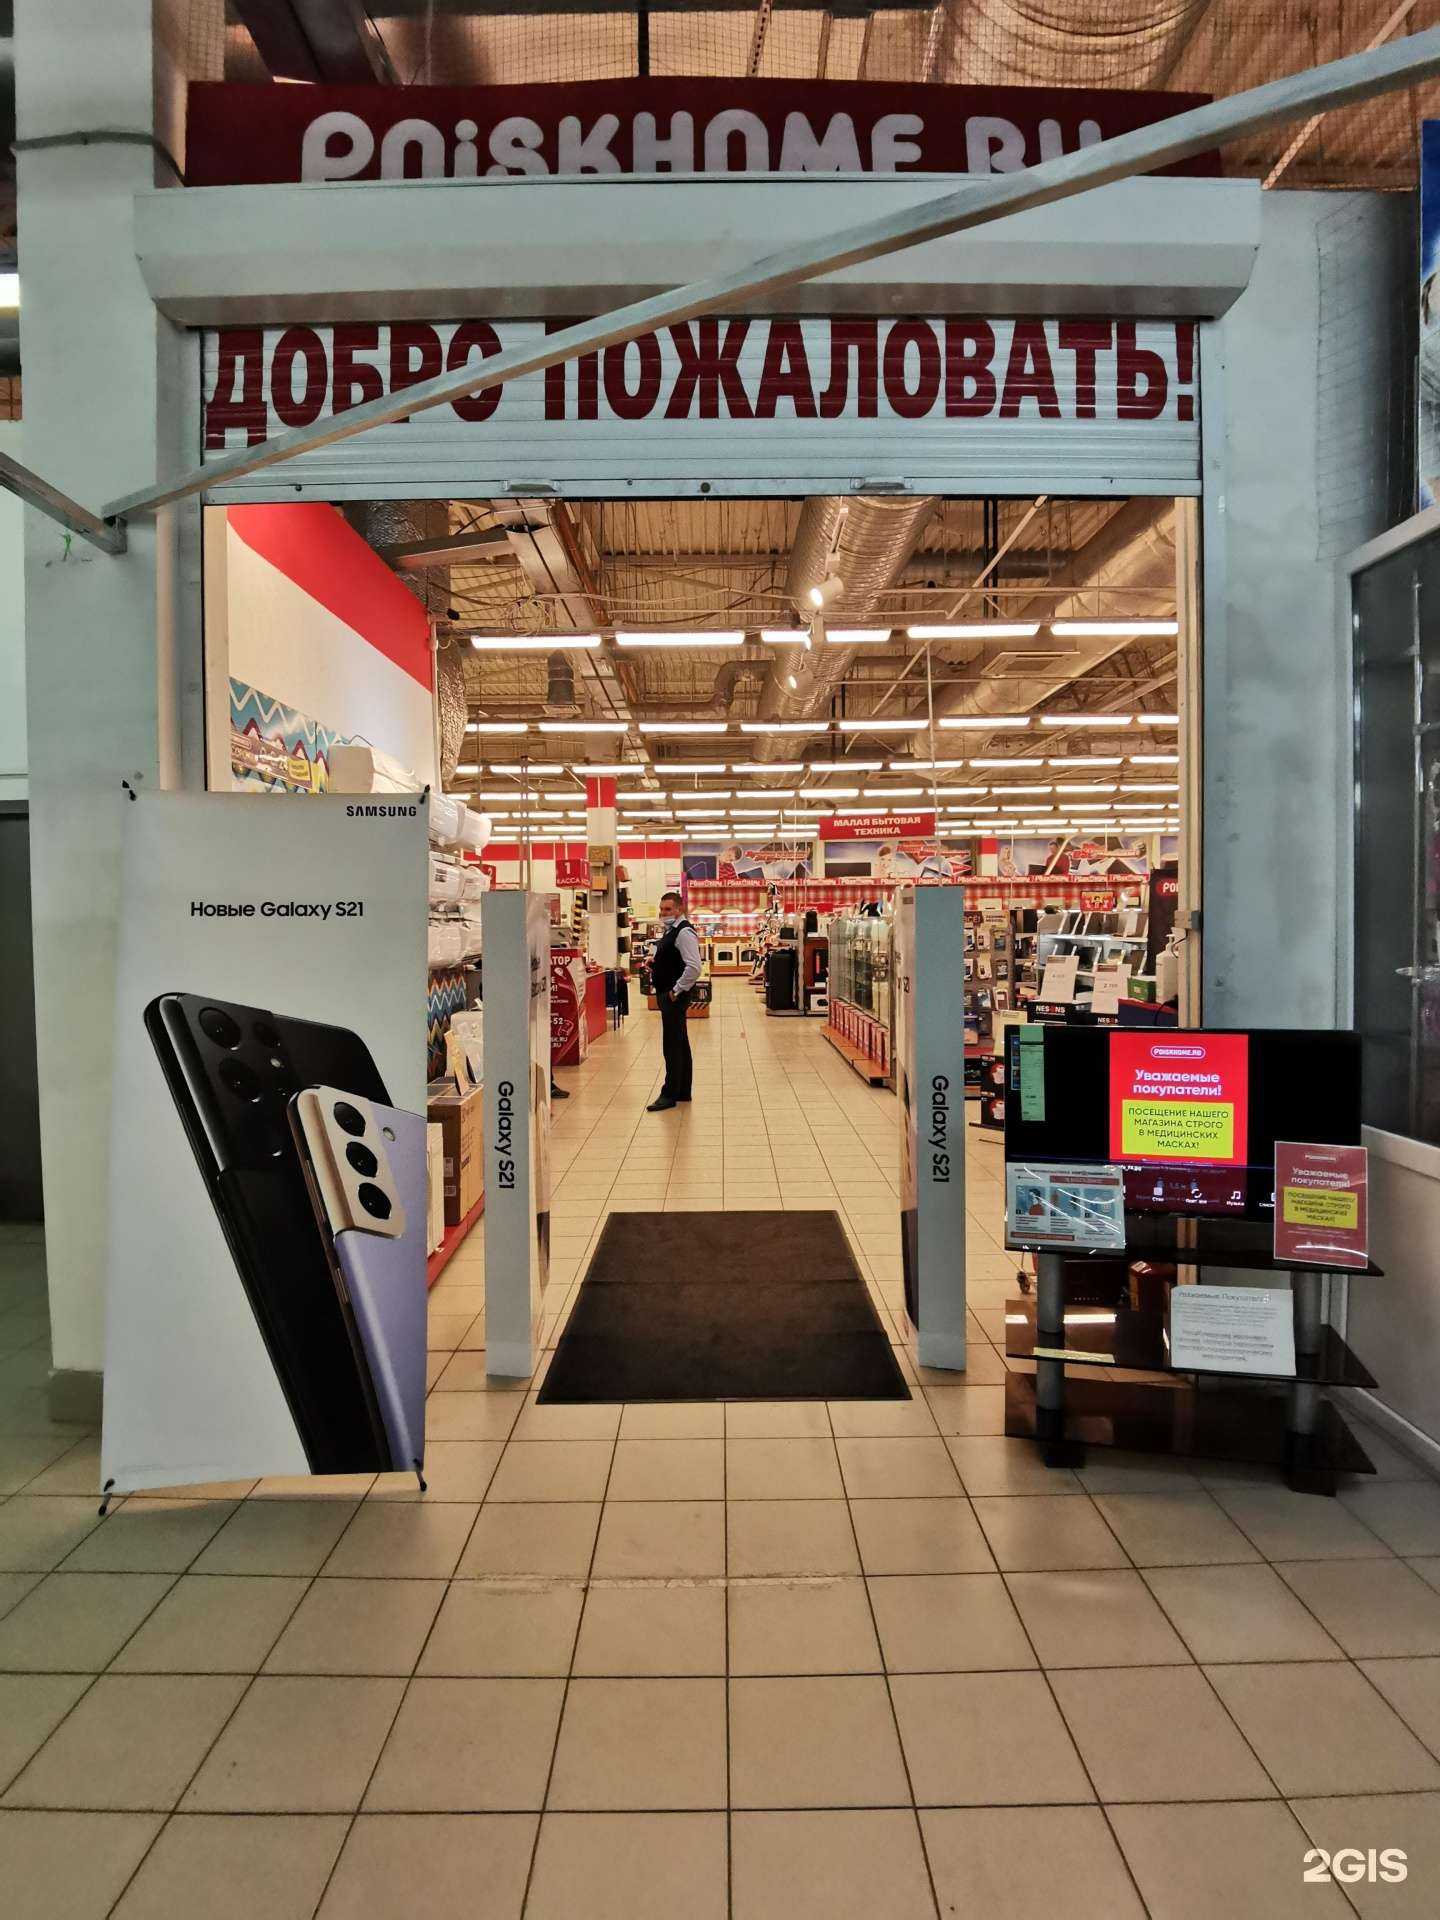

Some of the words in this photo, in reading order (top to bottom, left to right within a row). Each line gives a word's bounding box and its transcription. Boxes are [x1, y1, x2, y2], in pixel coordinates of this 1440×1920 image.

[346, 805, 417, 817] SAMSUNG
[833, 818, 870, 828] МАЛАЯ
[871, 816, 921, 827] БЫТОВАЯ
[854, 827, 901, 836] ТЕХНИКА
[190, 901, 256, 917] Новые
[261, 901, 331, 920] Galaxy
[336, 901, 364, 917] S21
[1135, 1069, 1220, 1083] Уважаемые
[1133, 1084, 1222, 1096] покупатели!
[495, 1080, 514, 1156] Galaxy
[928, 1075, 949, 1150] Galaxy
[1128, 1107, 1188, 1118] ПОСЕЩЕНИЕ
[1189, 1109, 1229, 1119] НАШЕГО
[1134, 1118, 1183, 1128] МАГАЗИНА
[1185, 1120, 1223, 1129] СТРОГО
[1147, 1130, 1218, 1139] МЕДИЦИНСКИХ
[1157, 1141, 1200, 1149] МАСКАХ!
[932, 1154, 950, 1183] S21
[498, 1160, 515, 1190] S21
